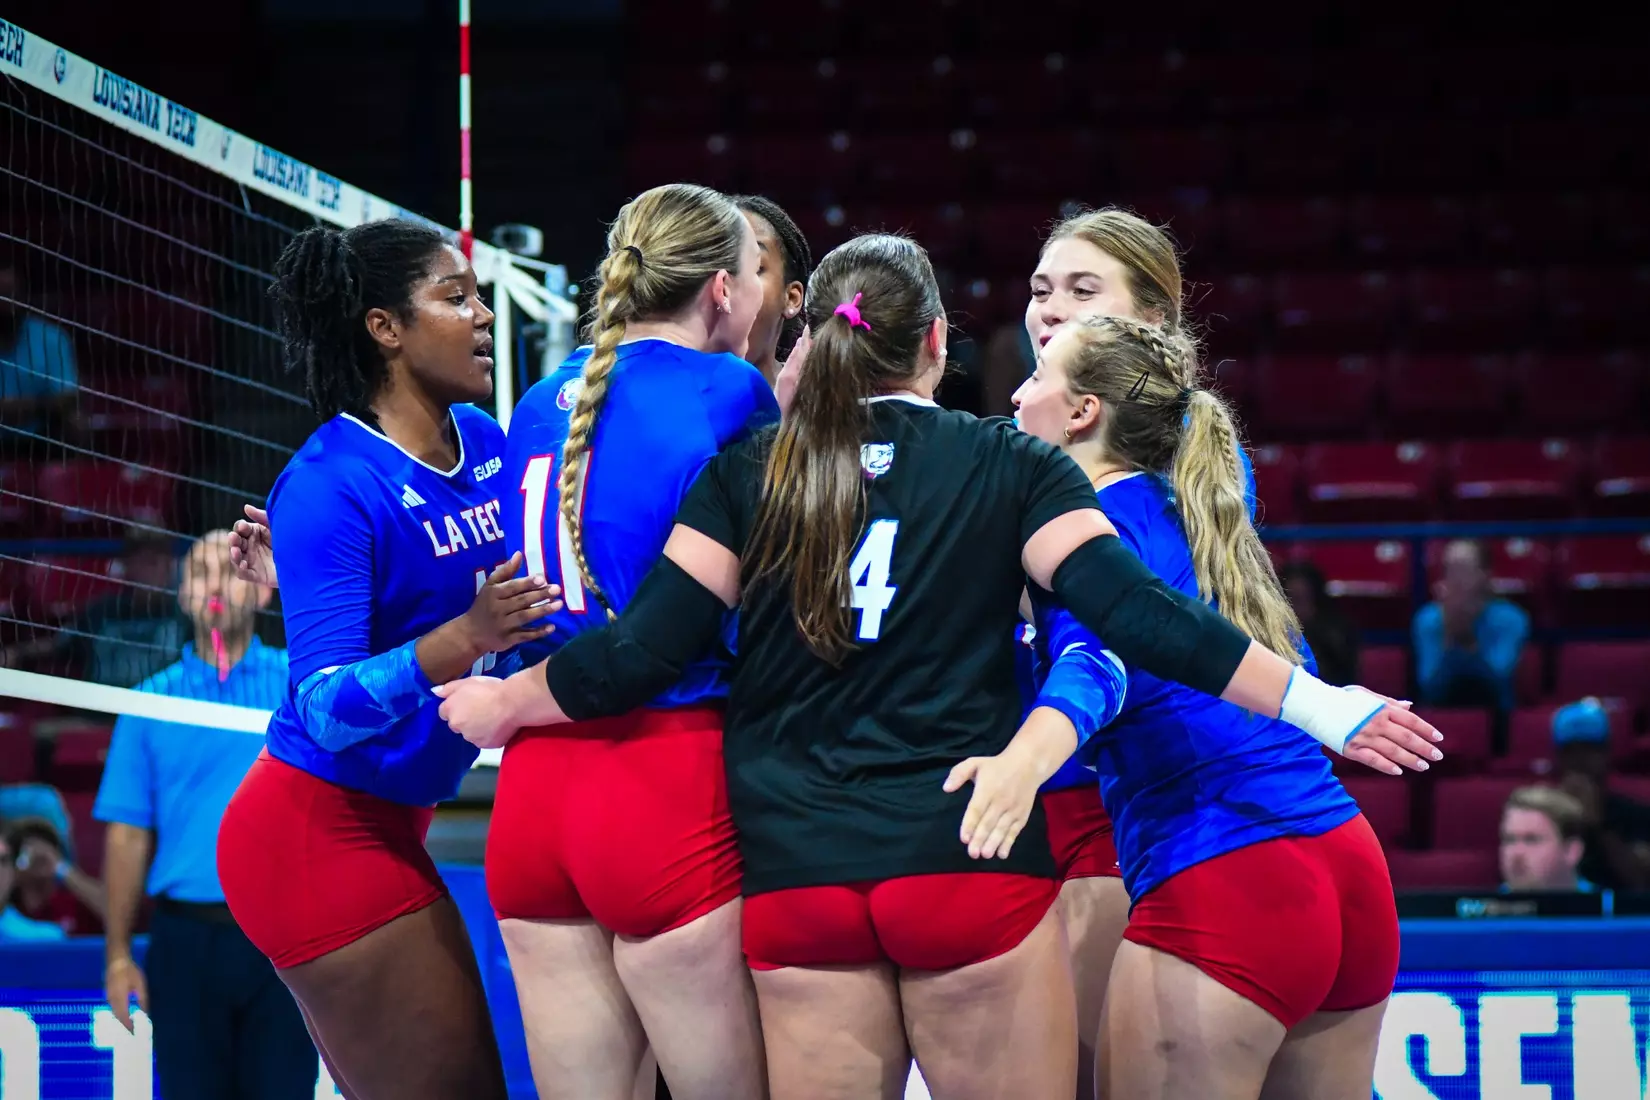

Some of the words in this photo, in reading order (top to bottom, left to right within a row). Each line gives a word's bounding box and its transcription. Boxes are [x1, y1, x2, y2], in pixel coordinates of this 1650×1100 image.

[93, 65, 160, 131] LOUISIANA
[166, 99, 198, 147] TECH
[423, 514, 469, 557] LA
[460, 498, 505, 546] TEC
[519, 446, 593, 614] 11
[841, 518, 900, 641] 4
